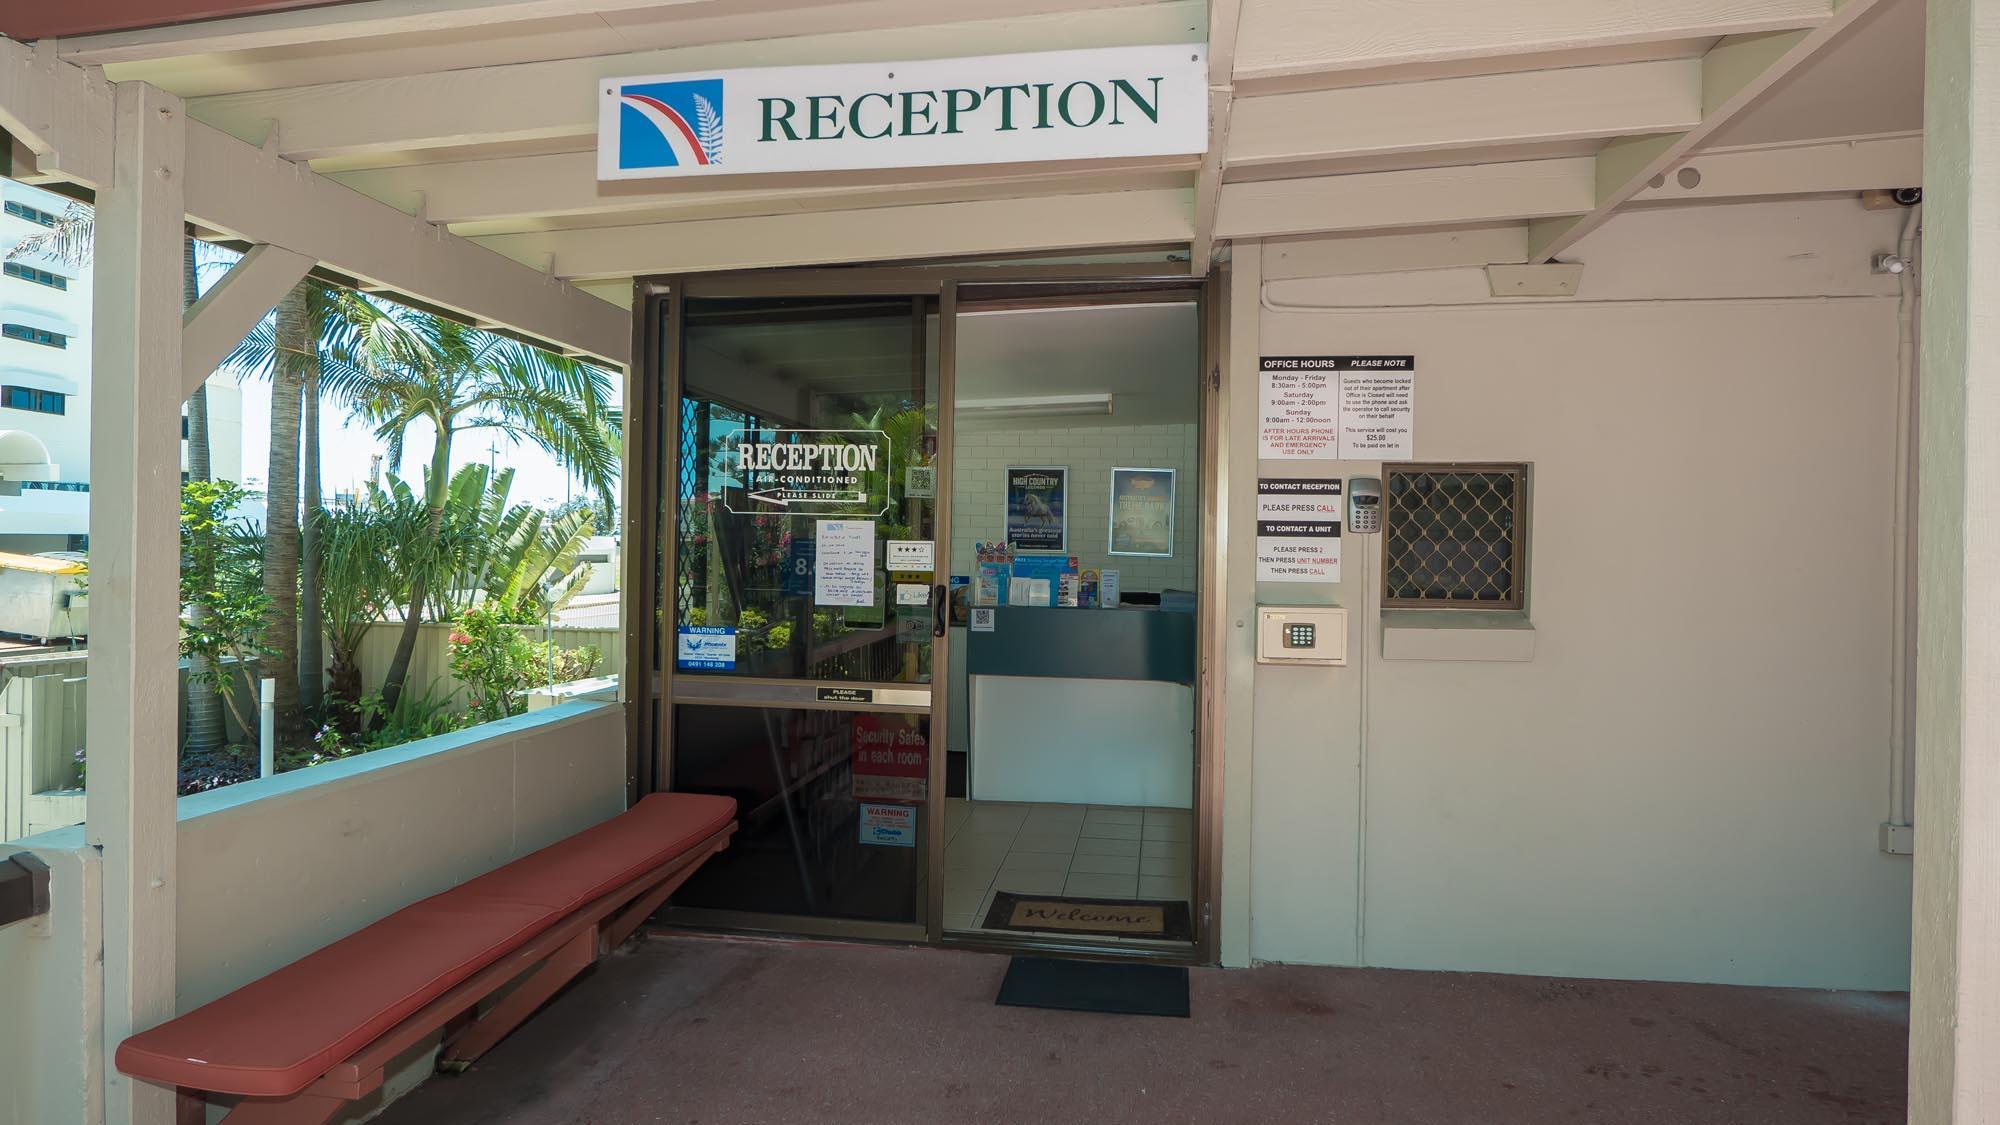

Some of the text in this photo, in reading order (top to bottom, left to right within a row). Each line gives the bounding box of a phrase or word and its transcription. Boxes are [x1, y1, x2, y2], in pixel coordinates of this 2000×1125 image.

[756, 77, 1164, 143] RECEPTION
[738, 444, 877, 471] RECEPTION
[1013, 478, 1058, 486] HIGH COUNTRY
[857, 727, 925, 746] Security Safes
[858, 747, 921, 765] in each room
[867, 807, 909, 817] WARNING
[1025, 908, 1150, 924] Welcome
